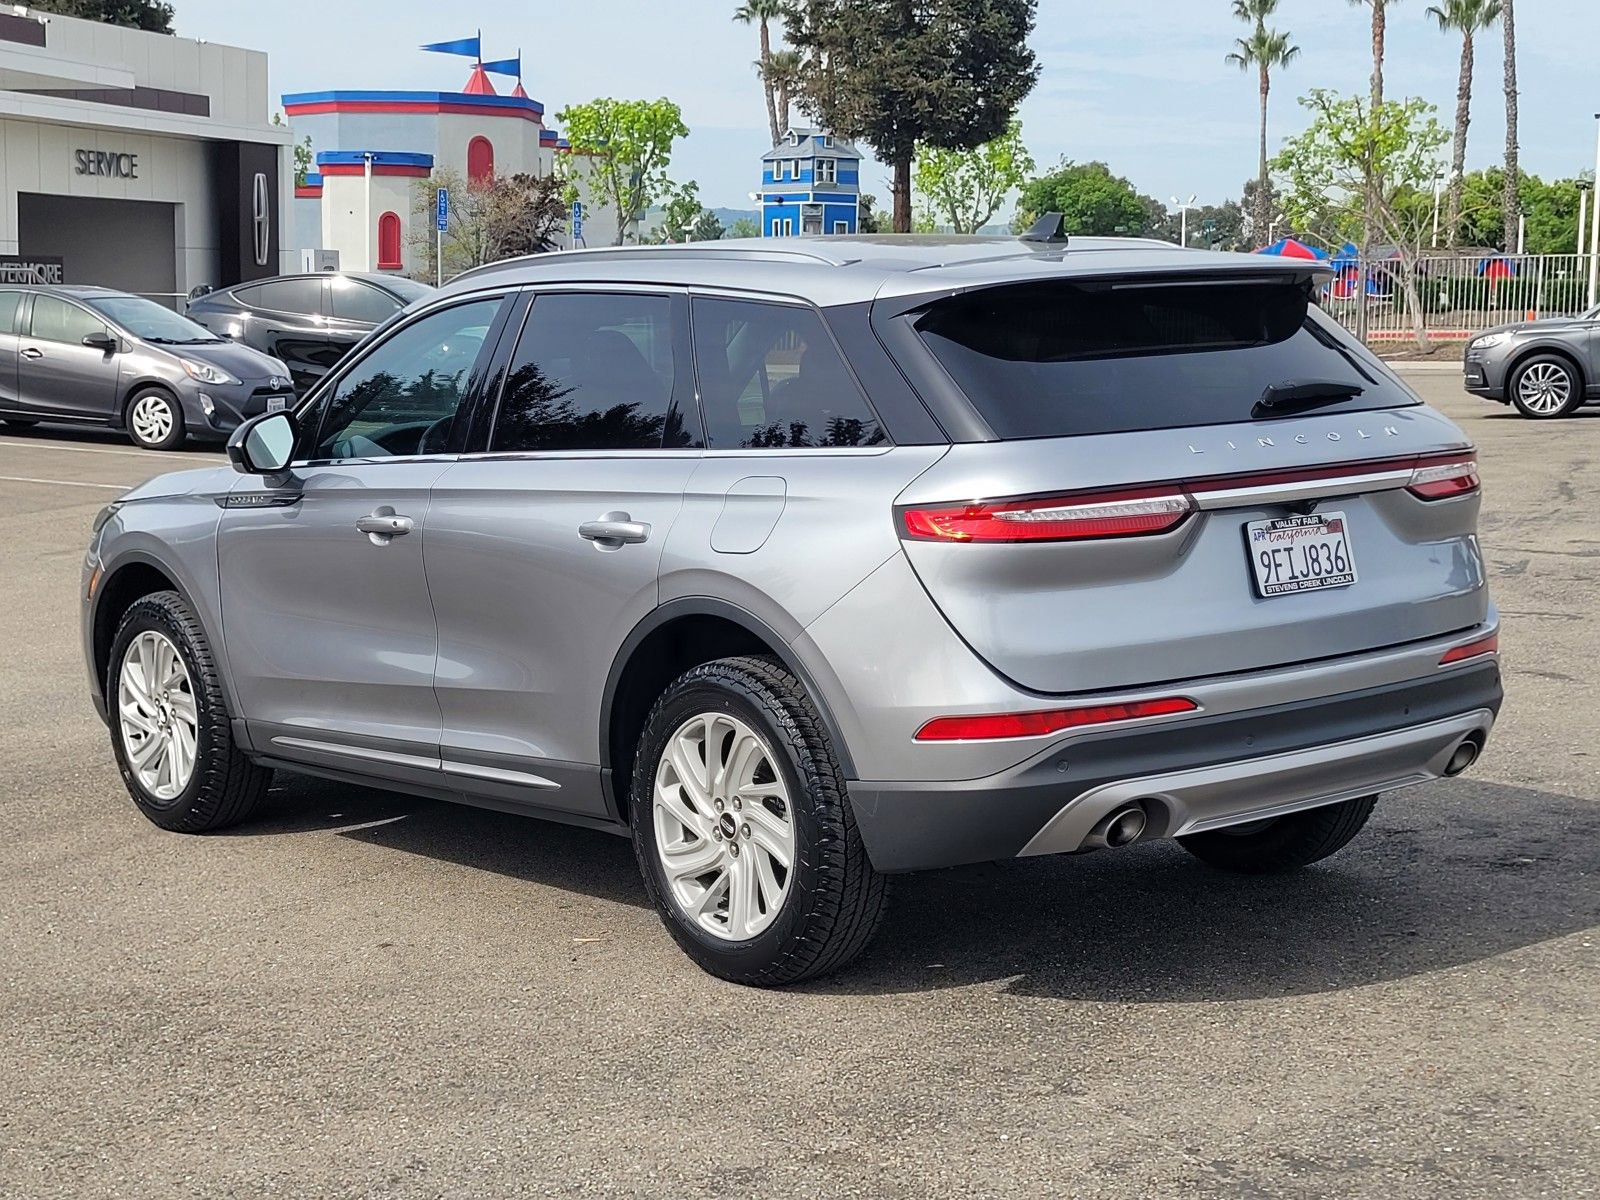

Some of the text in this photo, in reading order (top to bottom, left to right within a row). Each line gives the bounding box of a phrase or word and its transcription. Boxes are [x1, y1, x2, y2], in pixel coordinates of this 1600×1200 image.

[75, 149, 138, 179] SERVICE
[1188, 426, 1400, 454] LINCOLN
[1275, 516, 1319, 529] VALLEY FAIR
[1253, 531, 1267, 542] APR
[1269, 526, 1322, 545] California
[1260, 540, 1346, 584] 9FIJ836
[1266, 574, 1352, 593] STEVENS CREEK LINCOLN
